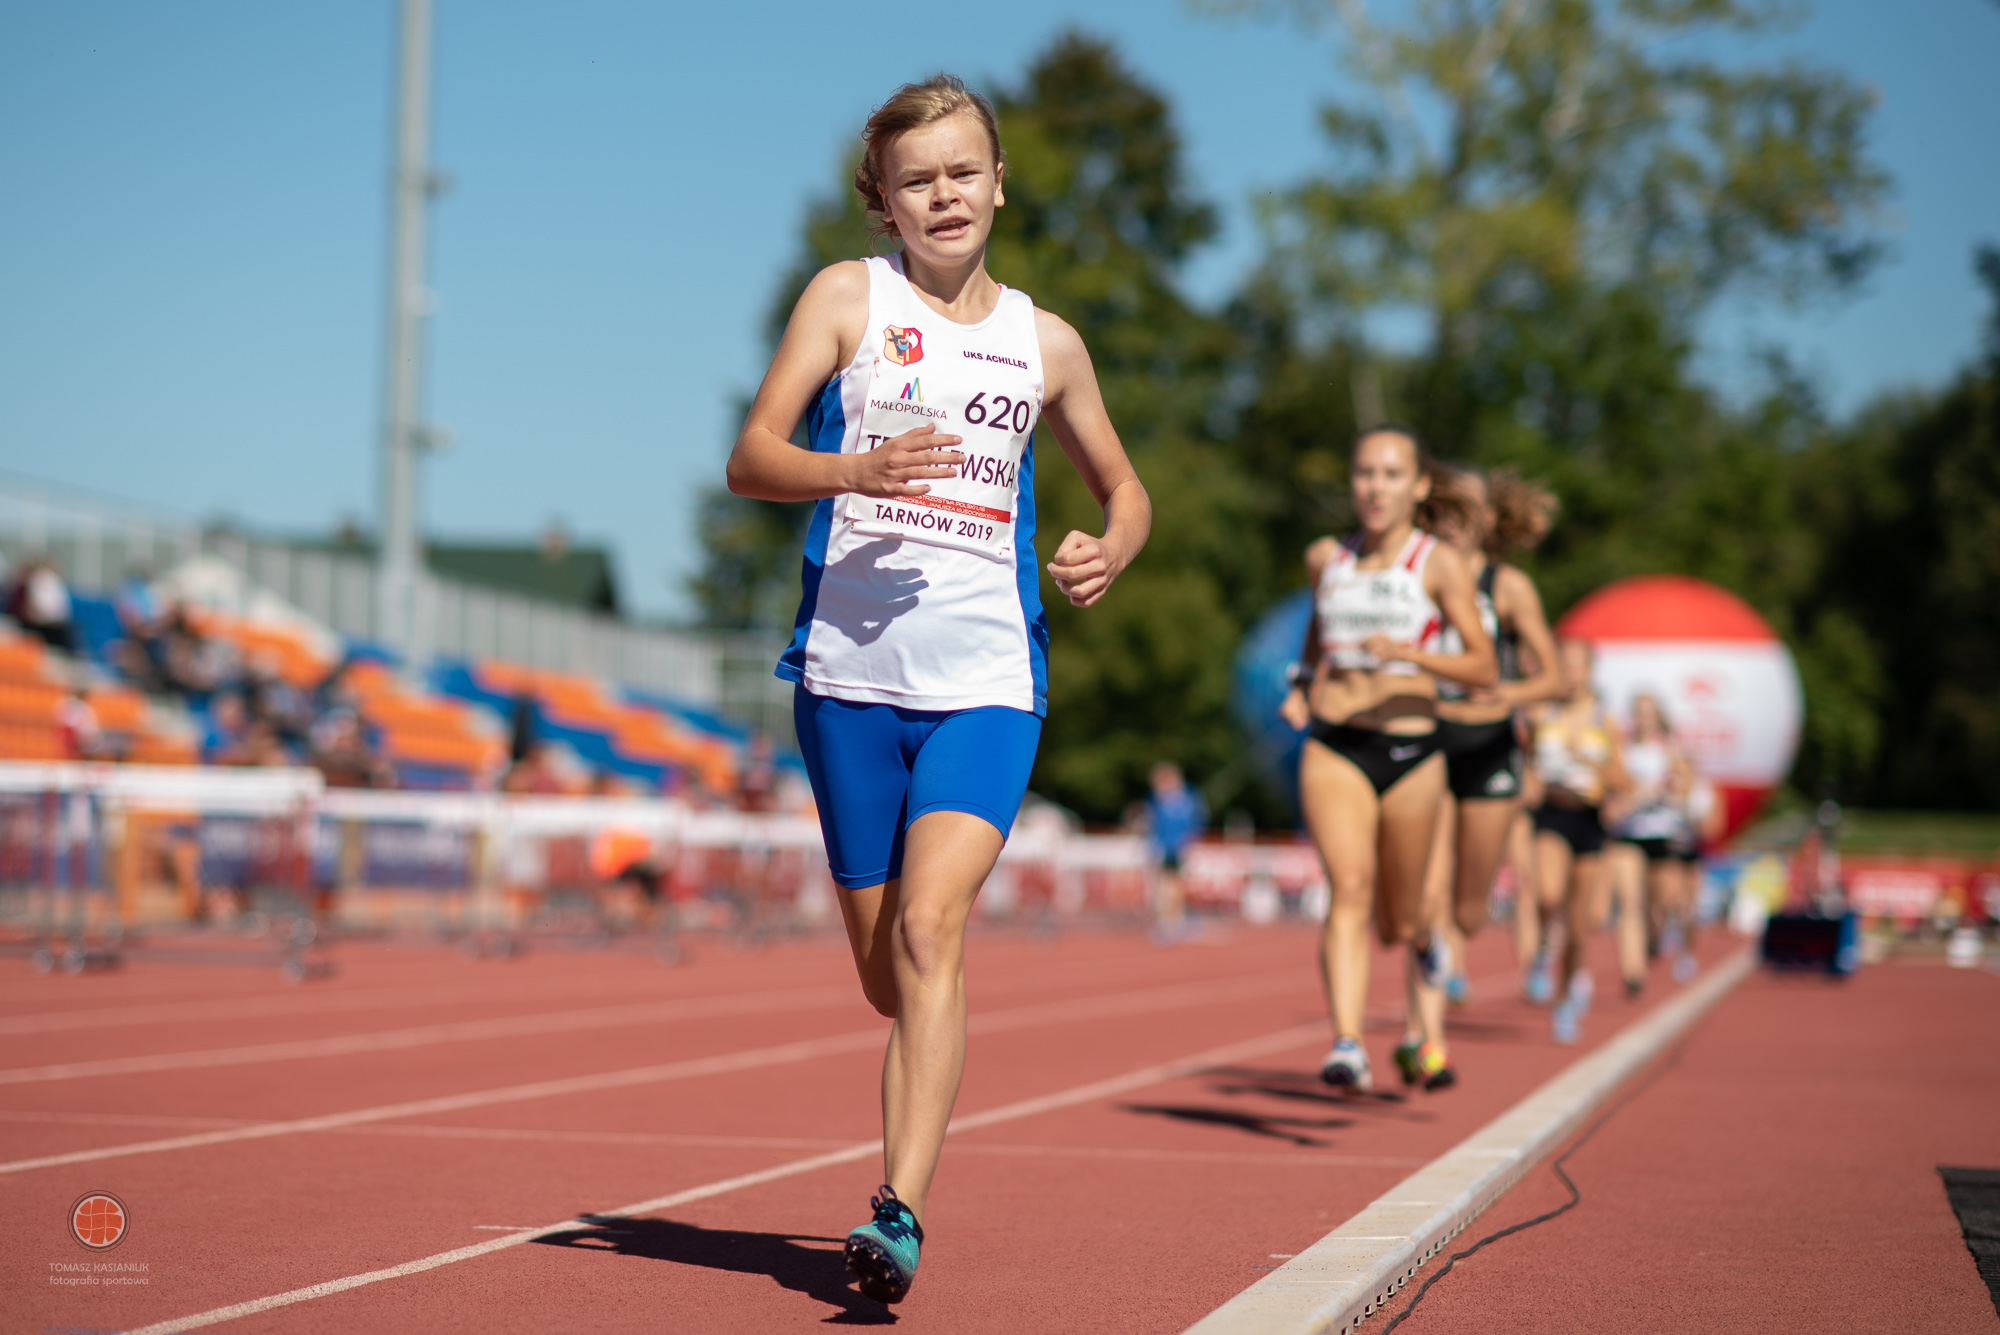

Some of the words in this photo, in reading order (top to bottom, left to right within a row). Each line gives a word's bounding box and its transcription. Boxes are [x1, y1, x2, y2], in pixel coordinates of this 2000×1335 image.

[963, 350, 984, 360] UKS
[986, 354, 1028, 370] ACHILLES
[870, 399, 948, 420] MAŁOPOLSKA
[964, 392, 1030, 434] 620
[876, 504, 953, 532] TARNÓW
[956, 521, 993, 540] 2019
